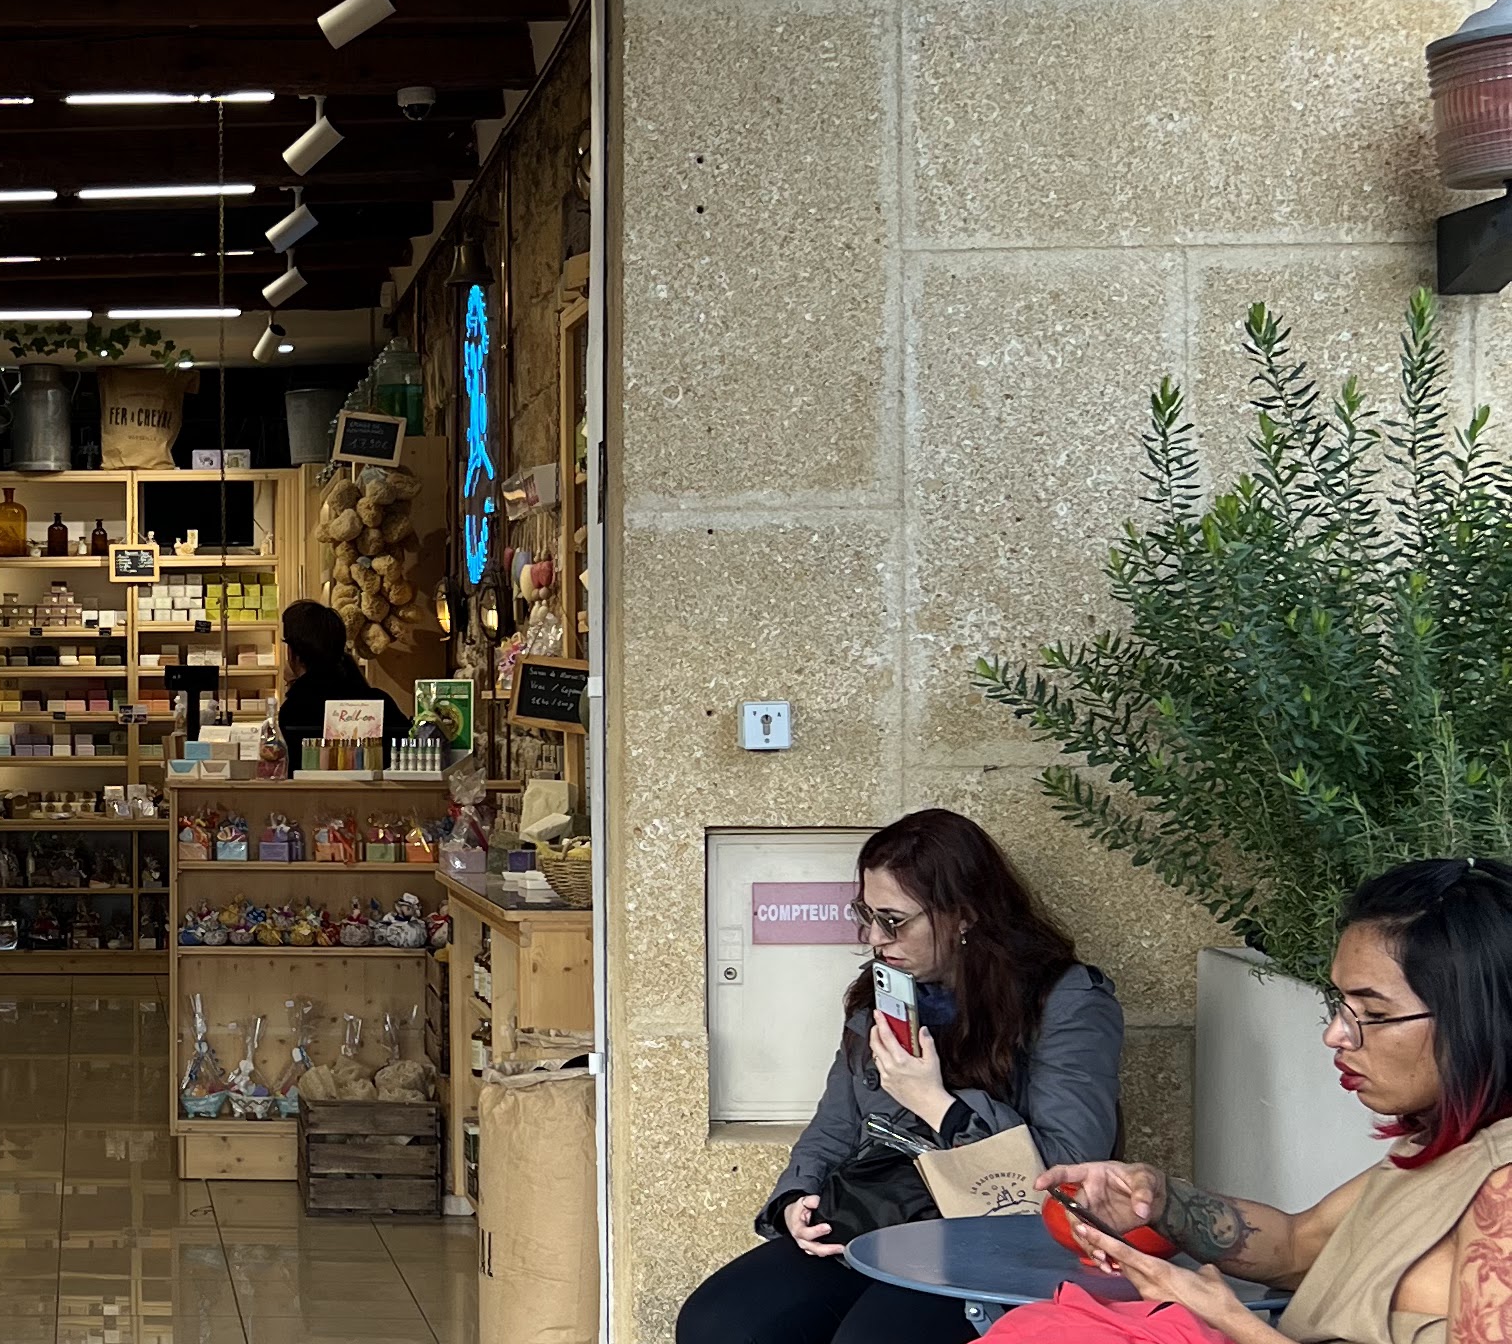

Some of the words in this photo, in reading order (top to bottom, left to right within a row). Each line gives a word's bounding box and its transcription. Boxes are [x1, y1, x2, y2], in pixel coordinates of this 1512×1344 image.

[109, 407, 128, 426] FER
[137, 407, 173, 429] CHEVAL
[757, 904, 839, 922] COMPTEUR
